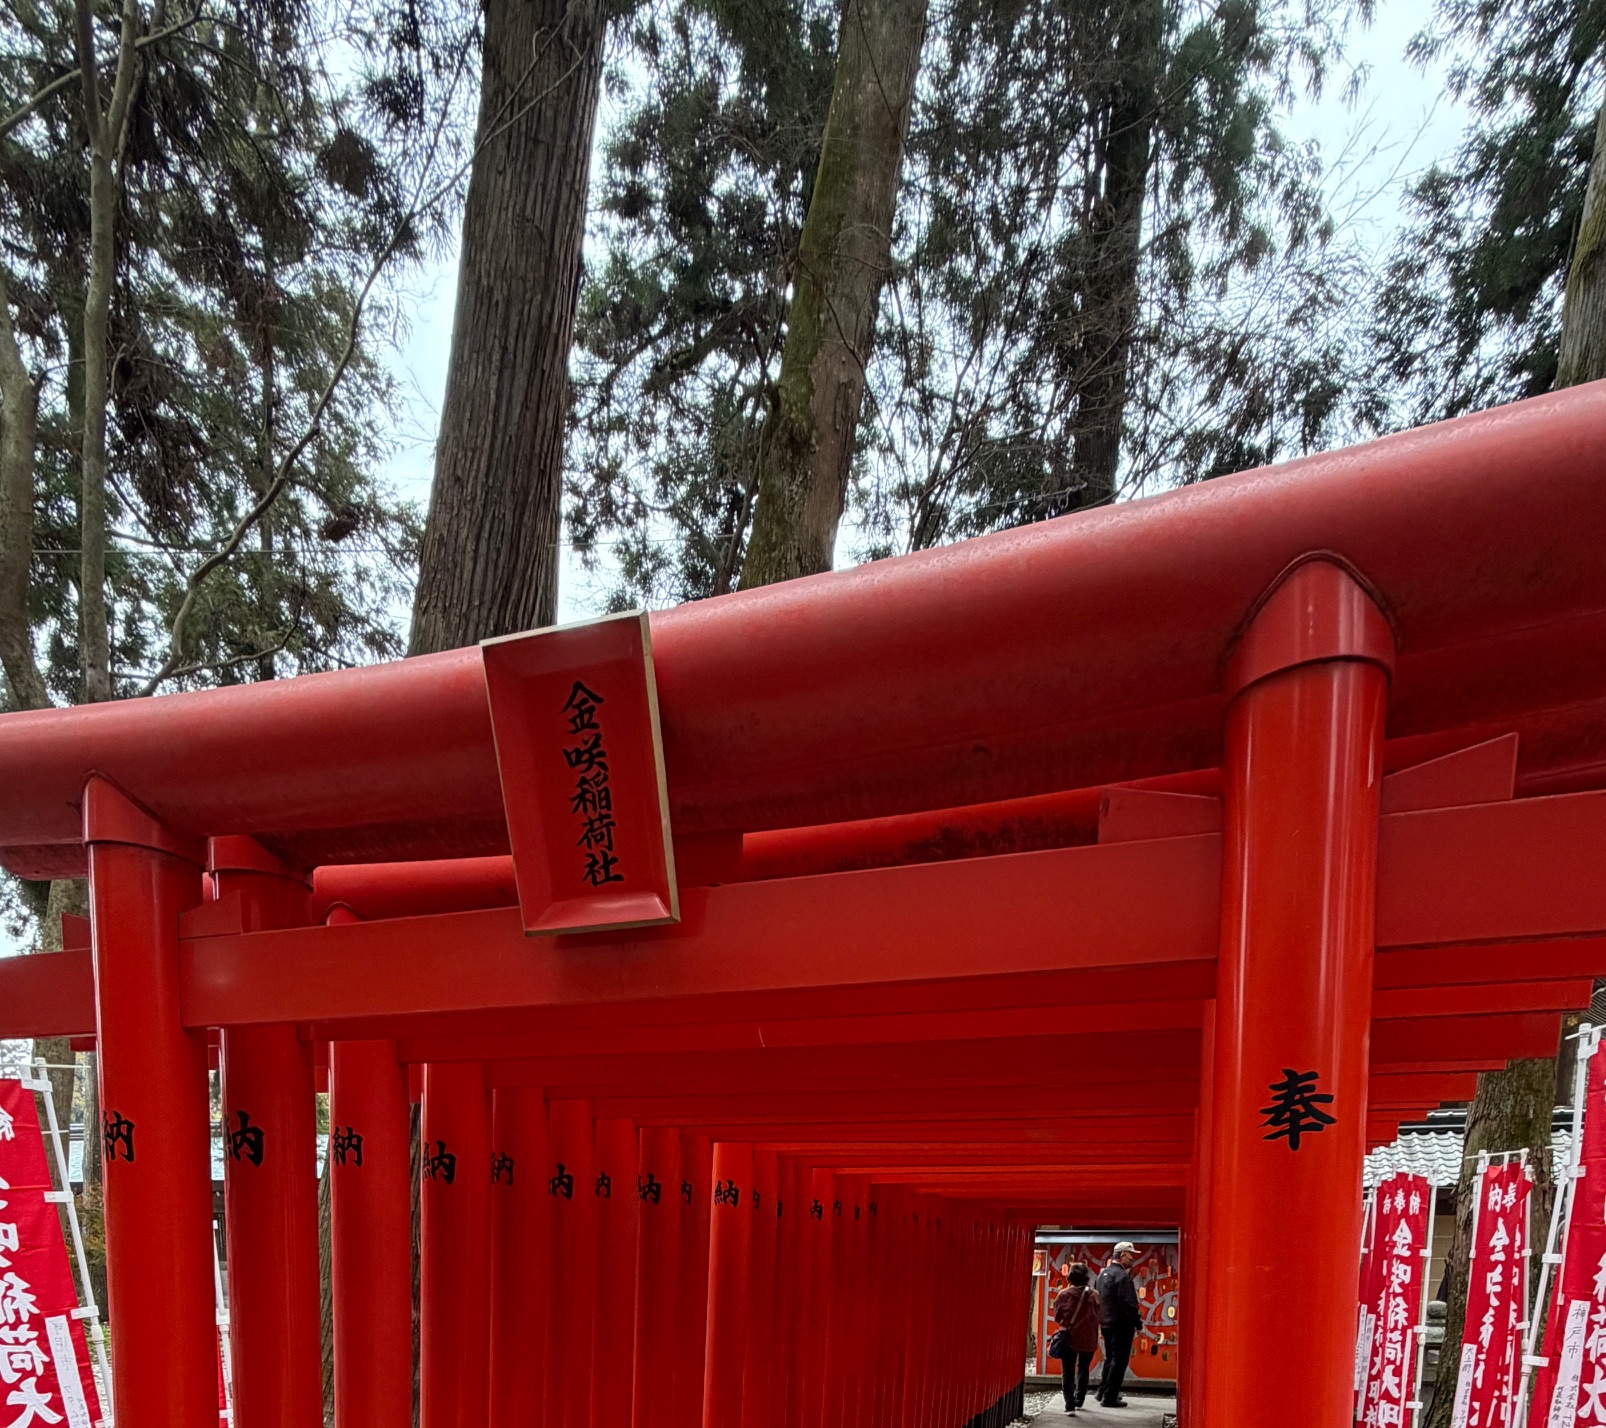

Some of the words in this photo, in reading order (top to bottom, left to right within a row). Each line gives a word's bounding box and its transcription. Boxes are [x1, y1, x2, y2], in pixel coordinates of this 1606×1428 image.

[561, 680, 624, 887] 金咲稲荷社
[1257, 1068, 1337, 1151] 奉
[333, 1126, 363, 1168] 納
[422, 1140, 457, 1184] 納
[714, 1179, 740, 1208] 納
